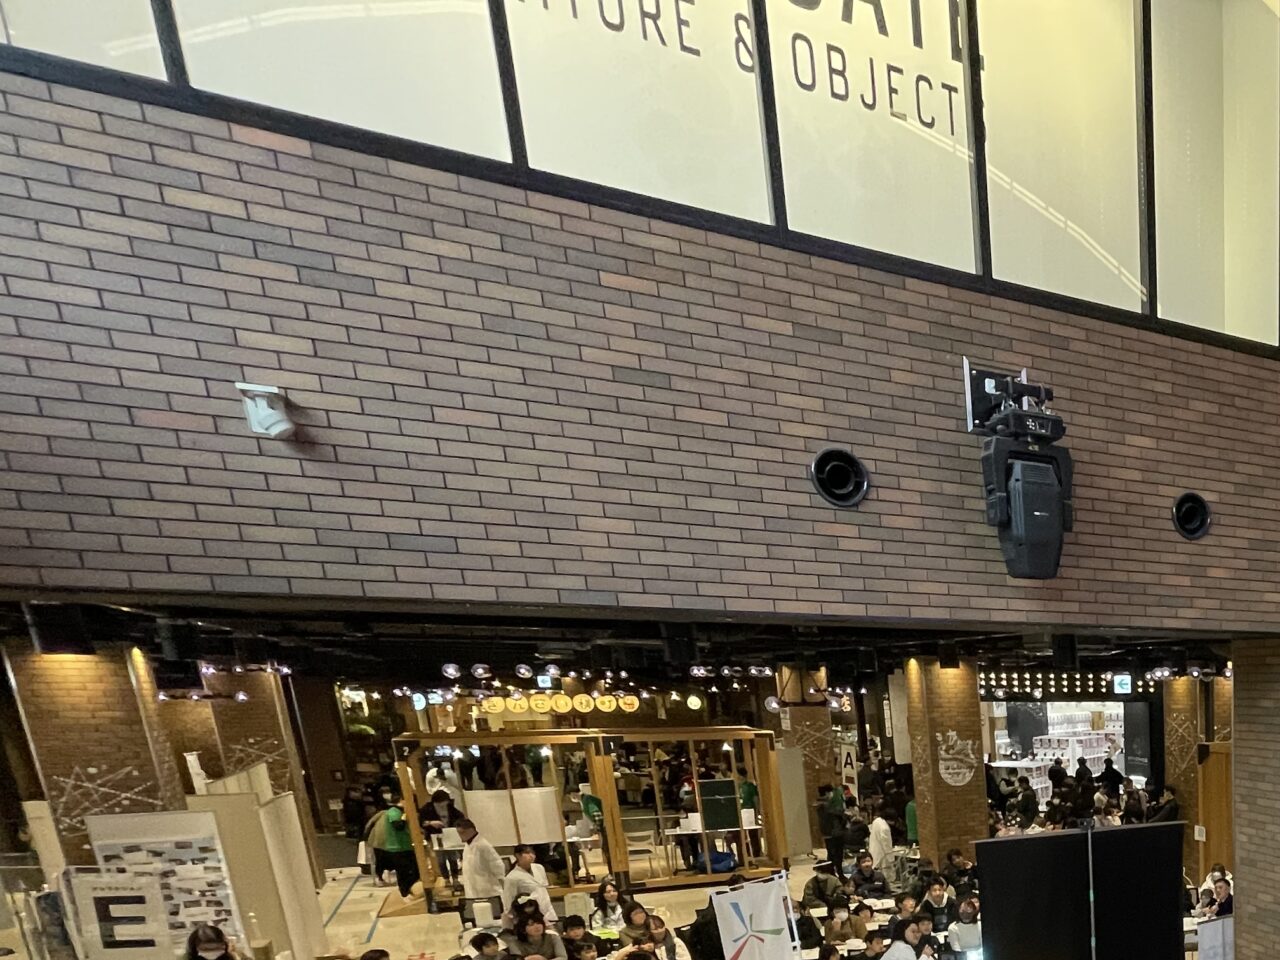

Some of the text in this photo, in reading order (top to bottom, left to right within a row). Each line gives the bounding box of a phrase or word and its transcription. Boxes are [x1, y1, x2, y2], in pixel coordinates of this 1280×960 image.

[734, 12, 756, 73] &
[843, 751, 854, 770] A
[93, 895, 156, 949] E
